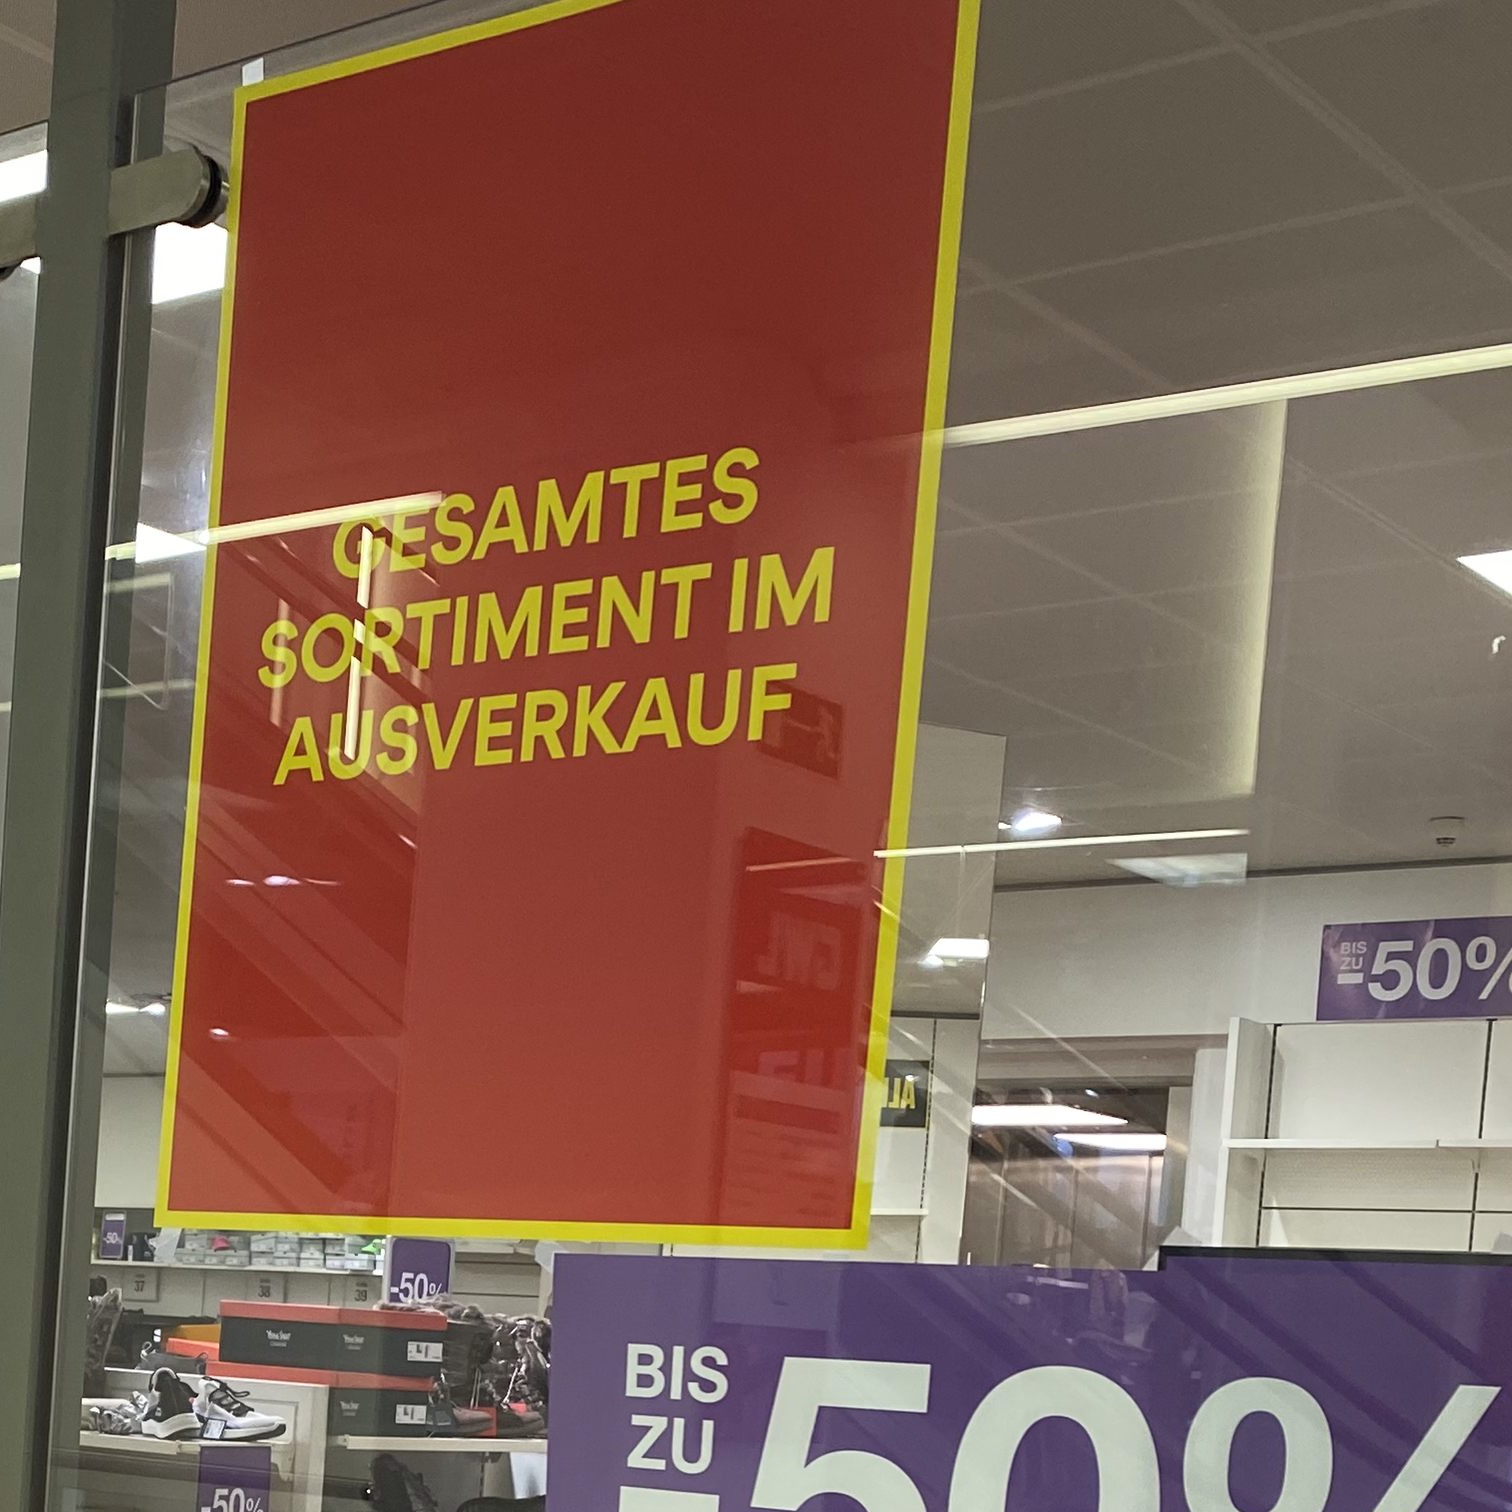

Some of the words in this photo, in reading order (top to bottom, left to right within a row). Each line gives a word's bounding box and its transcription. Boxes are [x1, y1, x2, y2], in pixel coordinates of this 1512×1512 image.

[333, 447, 761, 580] GESAMTES
[258, 566, 713, 689] SORTIMENT
[729, 547, 835, 632] IM
[274, 664, 798, 786] AUSVERKAUF
[1340, 941, 1368, 954] BIS
[1340, 957, 1364, 970] ZU
[624, 1342, 729, 1404] BIS
[625, 1414, 715, 1475] ZU
